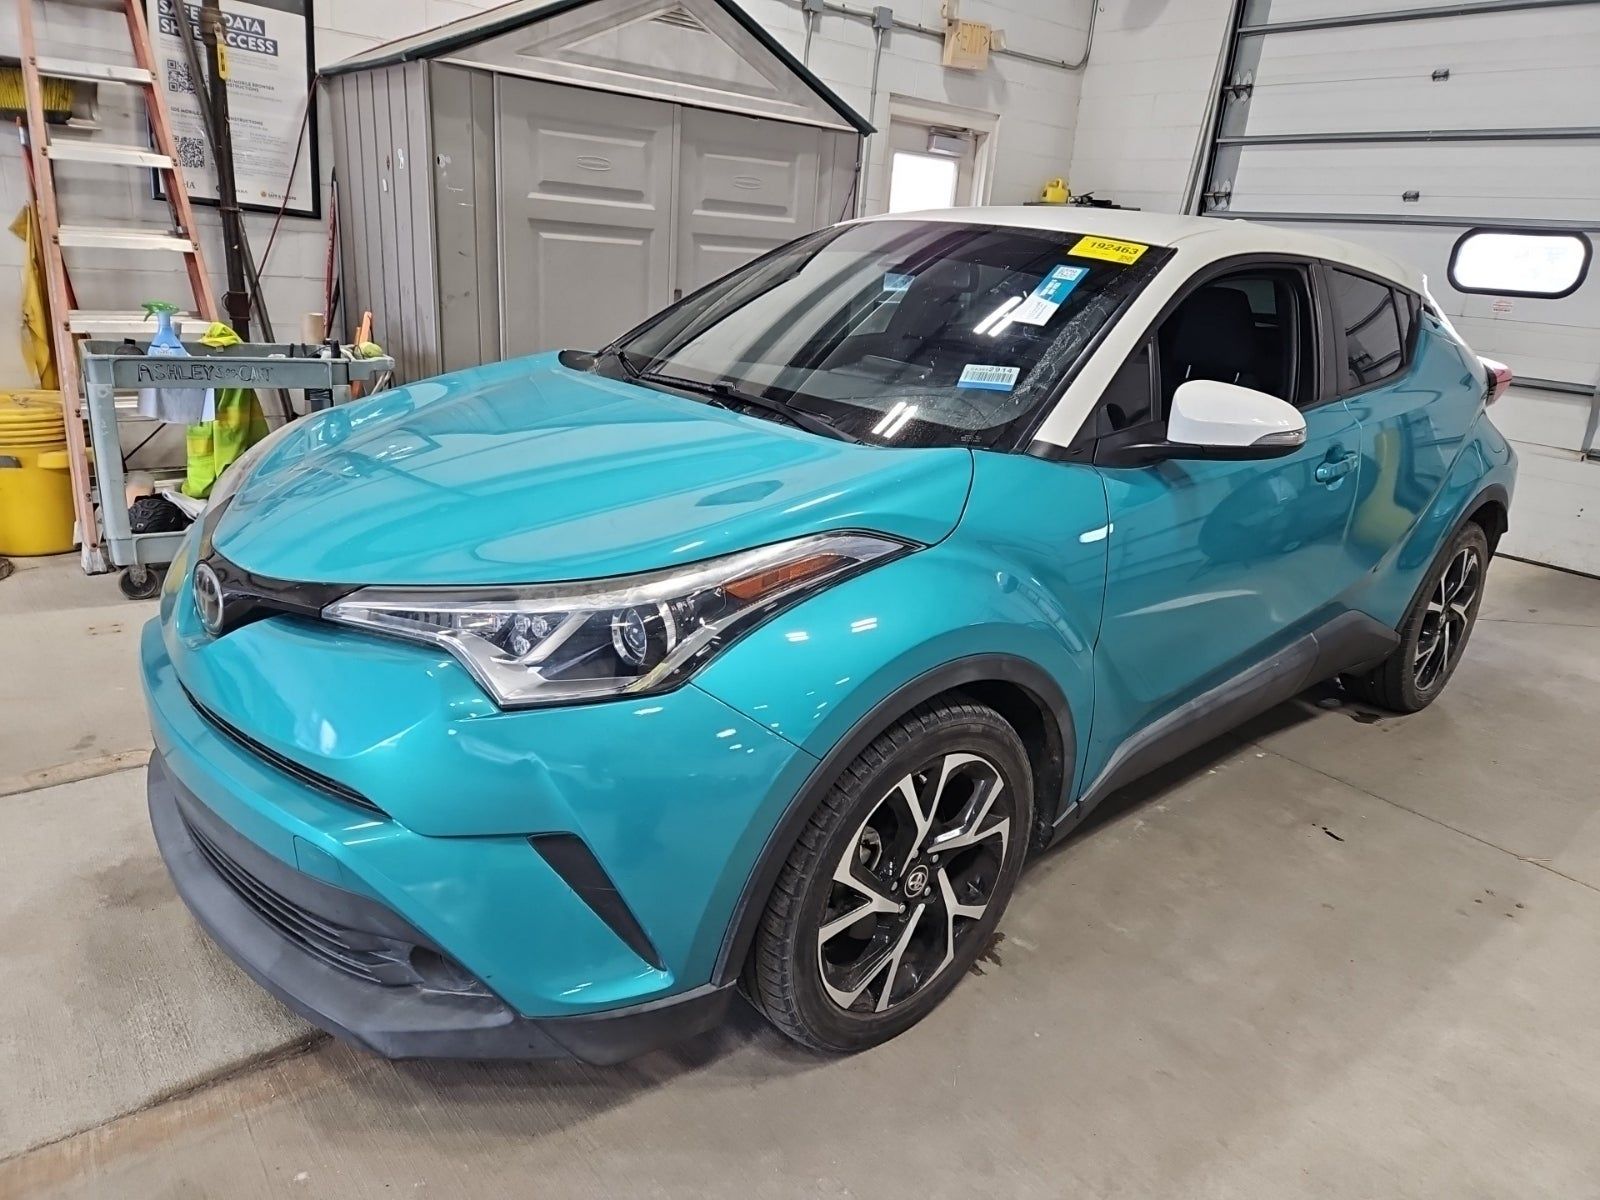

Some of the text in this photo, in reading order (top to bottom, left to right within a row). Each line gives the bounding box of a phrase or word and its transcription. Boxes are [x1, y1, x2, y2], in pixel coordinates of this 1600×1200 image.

[221, 13, 263, 34] DATA
[224, 32, 275, 54] CCESS
[1090, 241, 1139, 255] 192463
